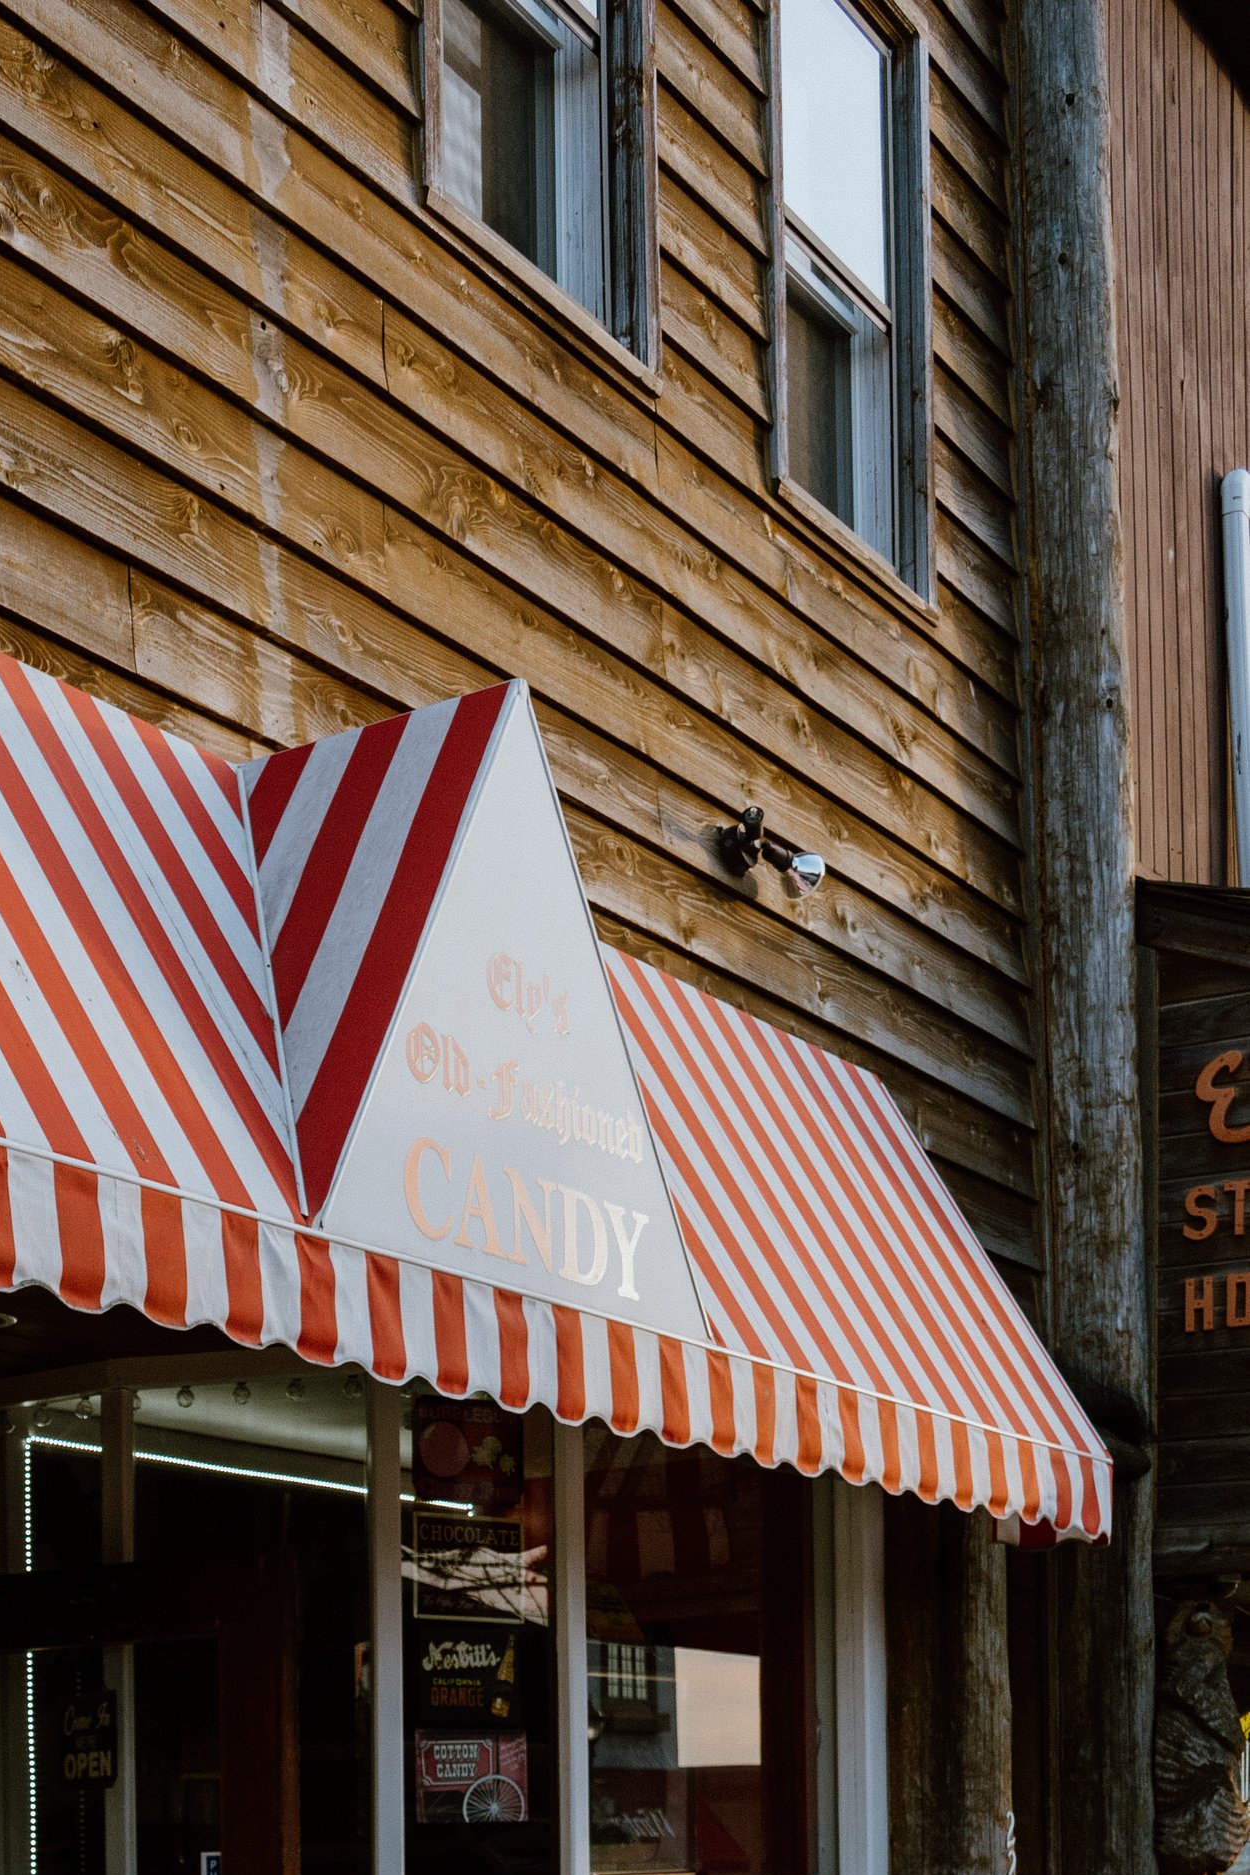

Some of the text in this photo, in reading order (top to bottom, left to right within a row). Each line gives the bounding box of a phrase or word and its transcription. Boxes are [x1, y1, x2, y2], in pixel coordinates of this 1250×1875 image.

[1195, 1050, 1250, 1143] E
[404, 1137, 649, 1300] CANDY
[1182, 1179, 1250, 1241] ST
[1184, 1272, 1250, 1333] HO
[419, 1523, 520, 1546] CHOCOLATE
[429, 1686, 485, 1707] ORANGE
[63, 1750, 112, 1781] OPEN
[433, 1744, 479, 1760] COTTON
[436, 1762, 477, 1779] CANDY
